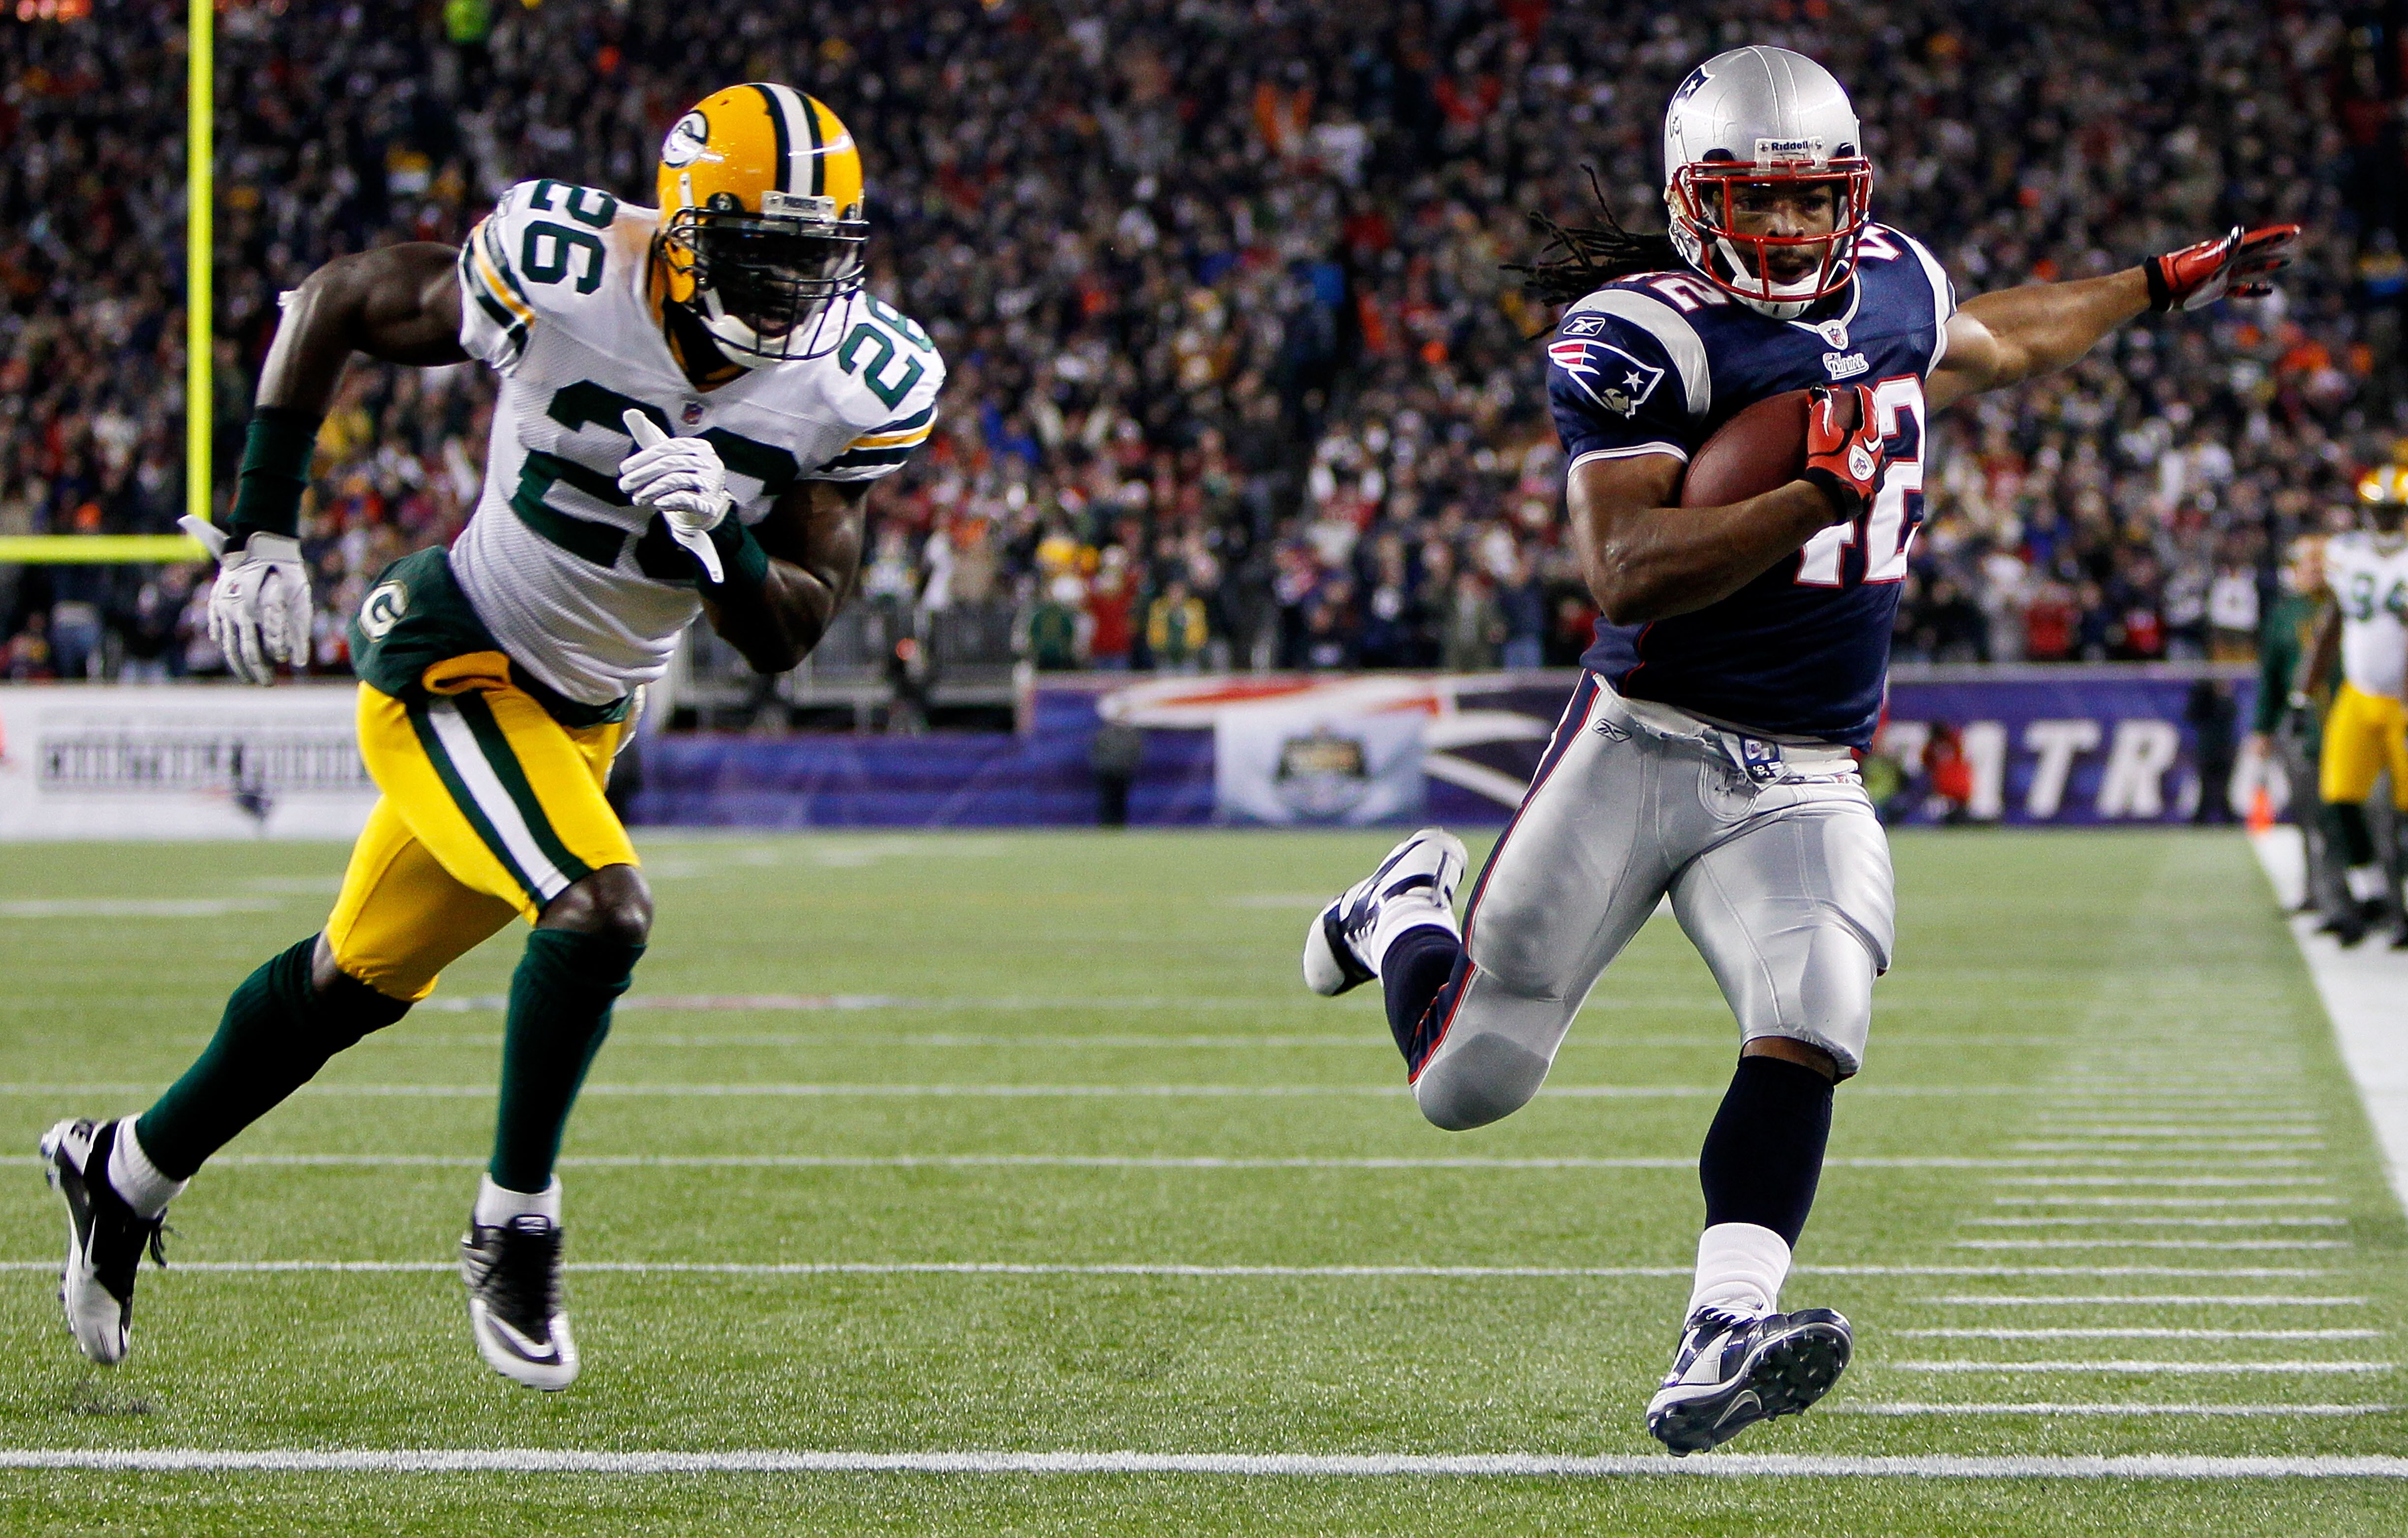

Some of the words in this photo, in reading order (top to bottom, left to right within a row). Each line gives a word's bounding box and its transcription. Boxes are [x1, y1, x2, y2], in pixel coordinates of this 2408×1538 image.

[521, 179, 618, 295] 26
[1826, 353, 1868, 379] Patriots
[360, 580, 409, 642] G
